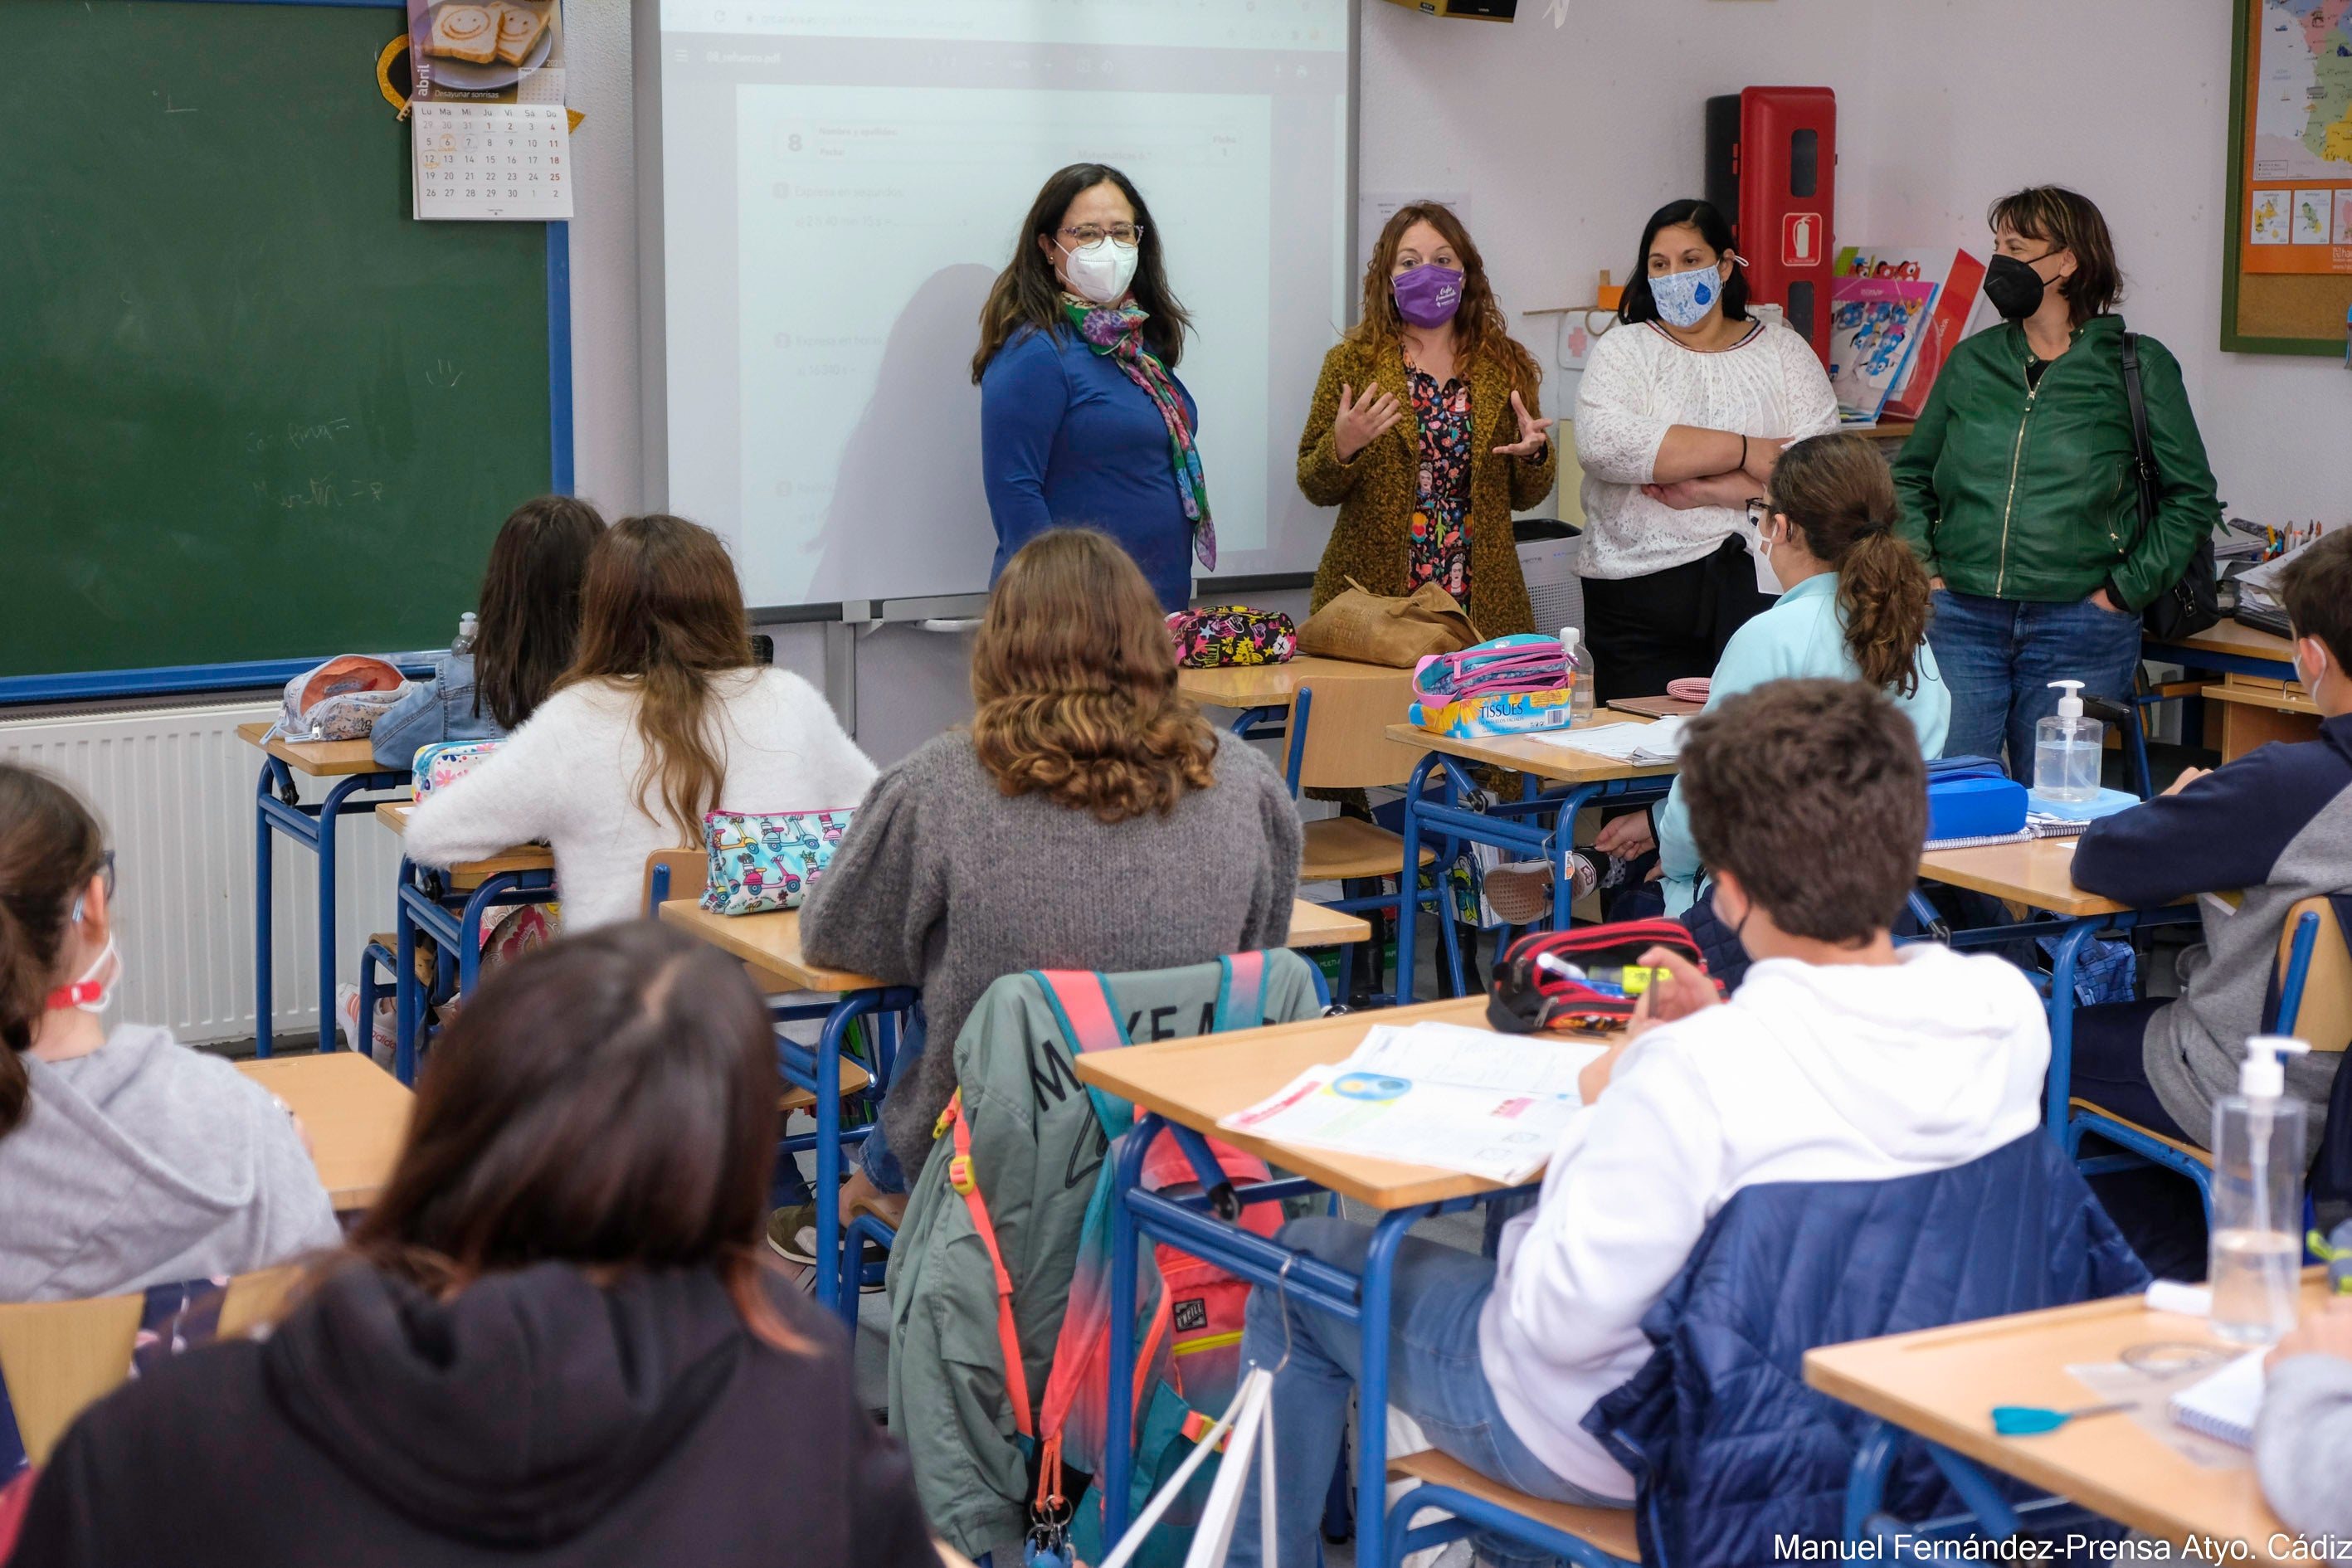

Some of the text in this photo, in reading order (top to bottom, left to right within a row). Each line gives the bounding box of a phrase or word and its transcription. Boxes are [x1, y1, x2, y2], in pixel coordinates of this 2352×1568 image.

[416, 64, 431, 96] abril
[435, 90, 470, 99] Desayunar
[421, 107, 432, 115] Lu
[439, 108, 451, 116] Ma
[461, 108, 471, 116] Mi
[423, 121, 433, 129] 29
[442, 121, 452, 129] 30
[463, 121, 472, 129] 31
[486, 122, 491, 130] 1
[529, 123, 533, 131] 3
[426, 138, 558, 148] 5 6 7 8 9 10 11
[787, 133, 803, 152] 8
[425, 154, 560, 165] 12 13 14 15 16 17 18
[426, 171, 436, 179] 19
[444, 172, 454, 180] 20
[465, 172, 475, 180] 21
[486, 173, 496, 181] 22
[507, 173, 518, 181] 23
[528, 173, 538, 181] 24
[426, 188, 436, 197] 26
[445, 188, 455, 197] 27
[465, 189, 475, 197] 28
[486, 189, 496, 197] 29
[508, 189, 518, 197] 30
[553, 189, 558, 197] 2
[1479, 702, 1523, 718] TISSUES
[373, 1030, 397, 1049] adida
